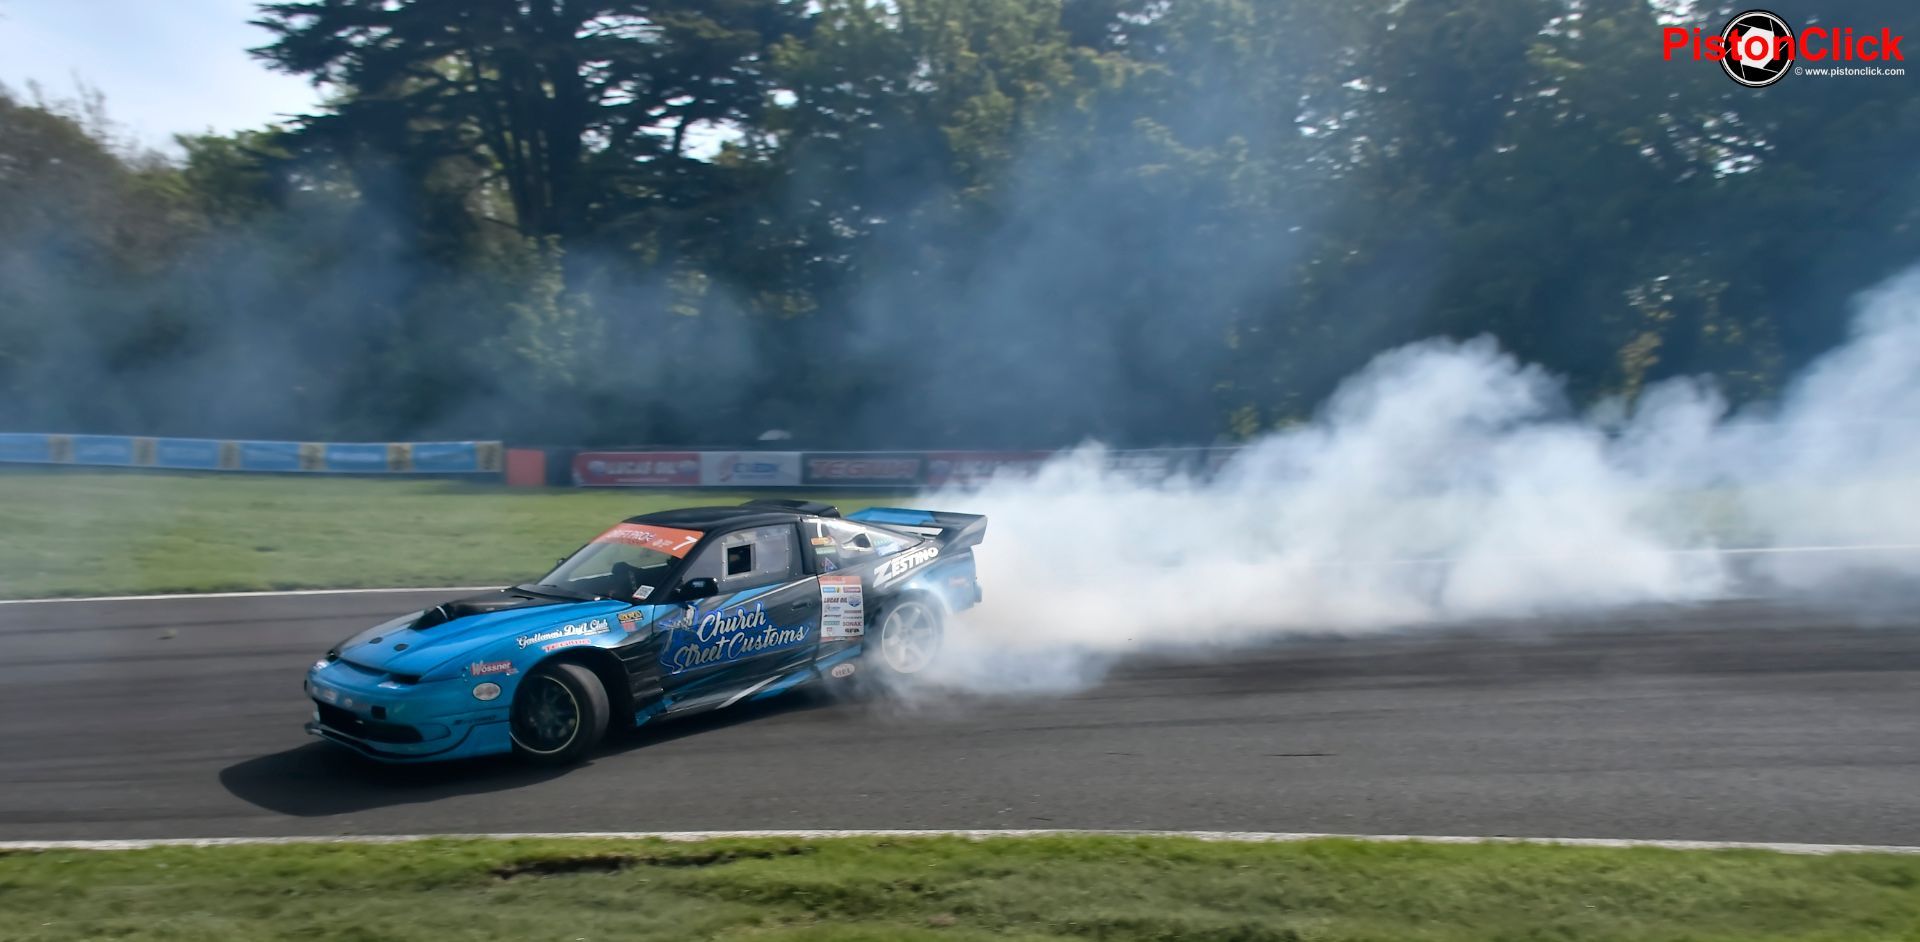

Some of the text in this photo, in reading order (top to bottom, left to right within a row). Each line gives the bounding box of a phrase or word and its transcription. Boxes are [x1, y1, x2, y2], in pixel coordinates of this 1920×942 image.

[671, 535, 698, 551] 7
[873, 547, 939, 588] ZESTINO
[517, 629, 562, 649] Gentlemen's
[590, 619, 608, 630] Club
[697, 603, 766, 642] Church
[672, 624, 809, 674] Street Customs
